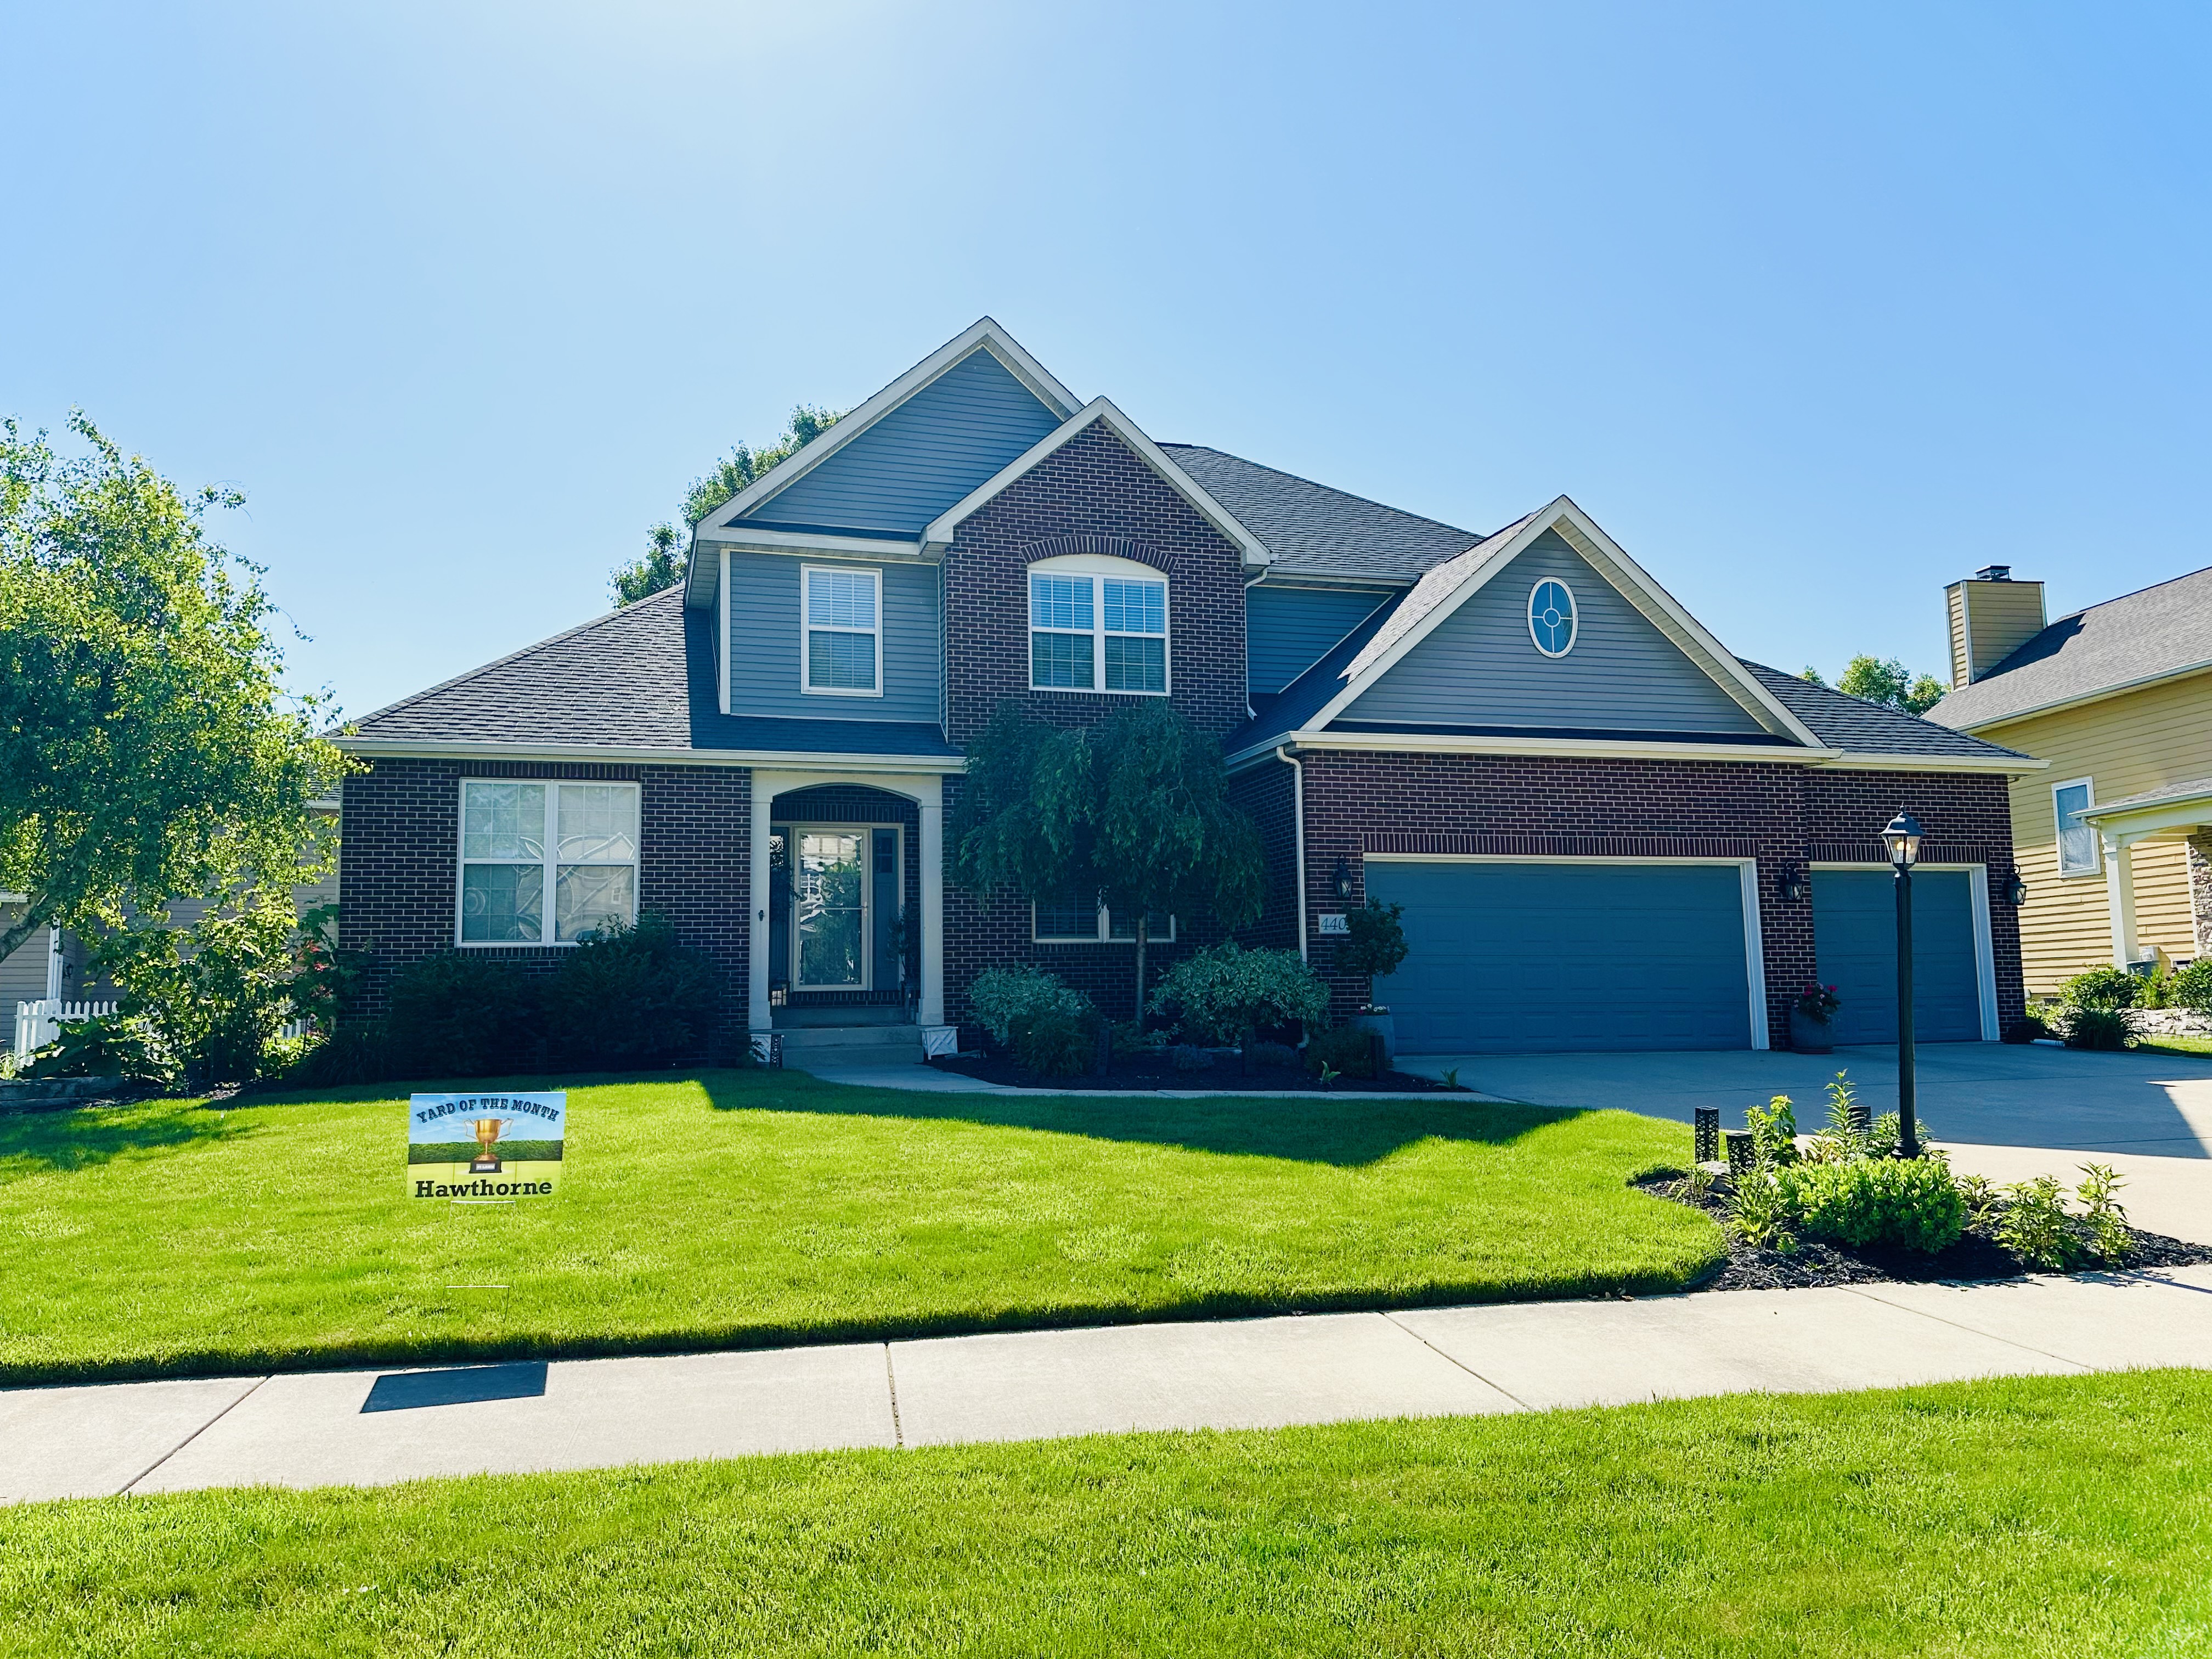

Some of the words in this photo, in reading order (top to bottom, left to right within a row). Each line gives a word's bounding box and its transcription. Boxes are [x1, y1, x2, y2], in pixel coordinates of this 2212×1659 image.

[416, 1103, 455, 1123] YARD
[459, 1099, 477, 1111] OF
[481, 1098, 508, 1110] THE
[511, 1099, 560, 1121] MONTH
[415, 1180, 552, 1197] Hawthorne
